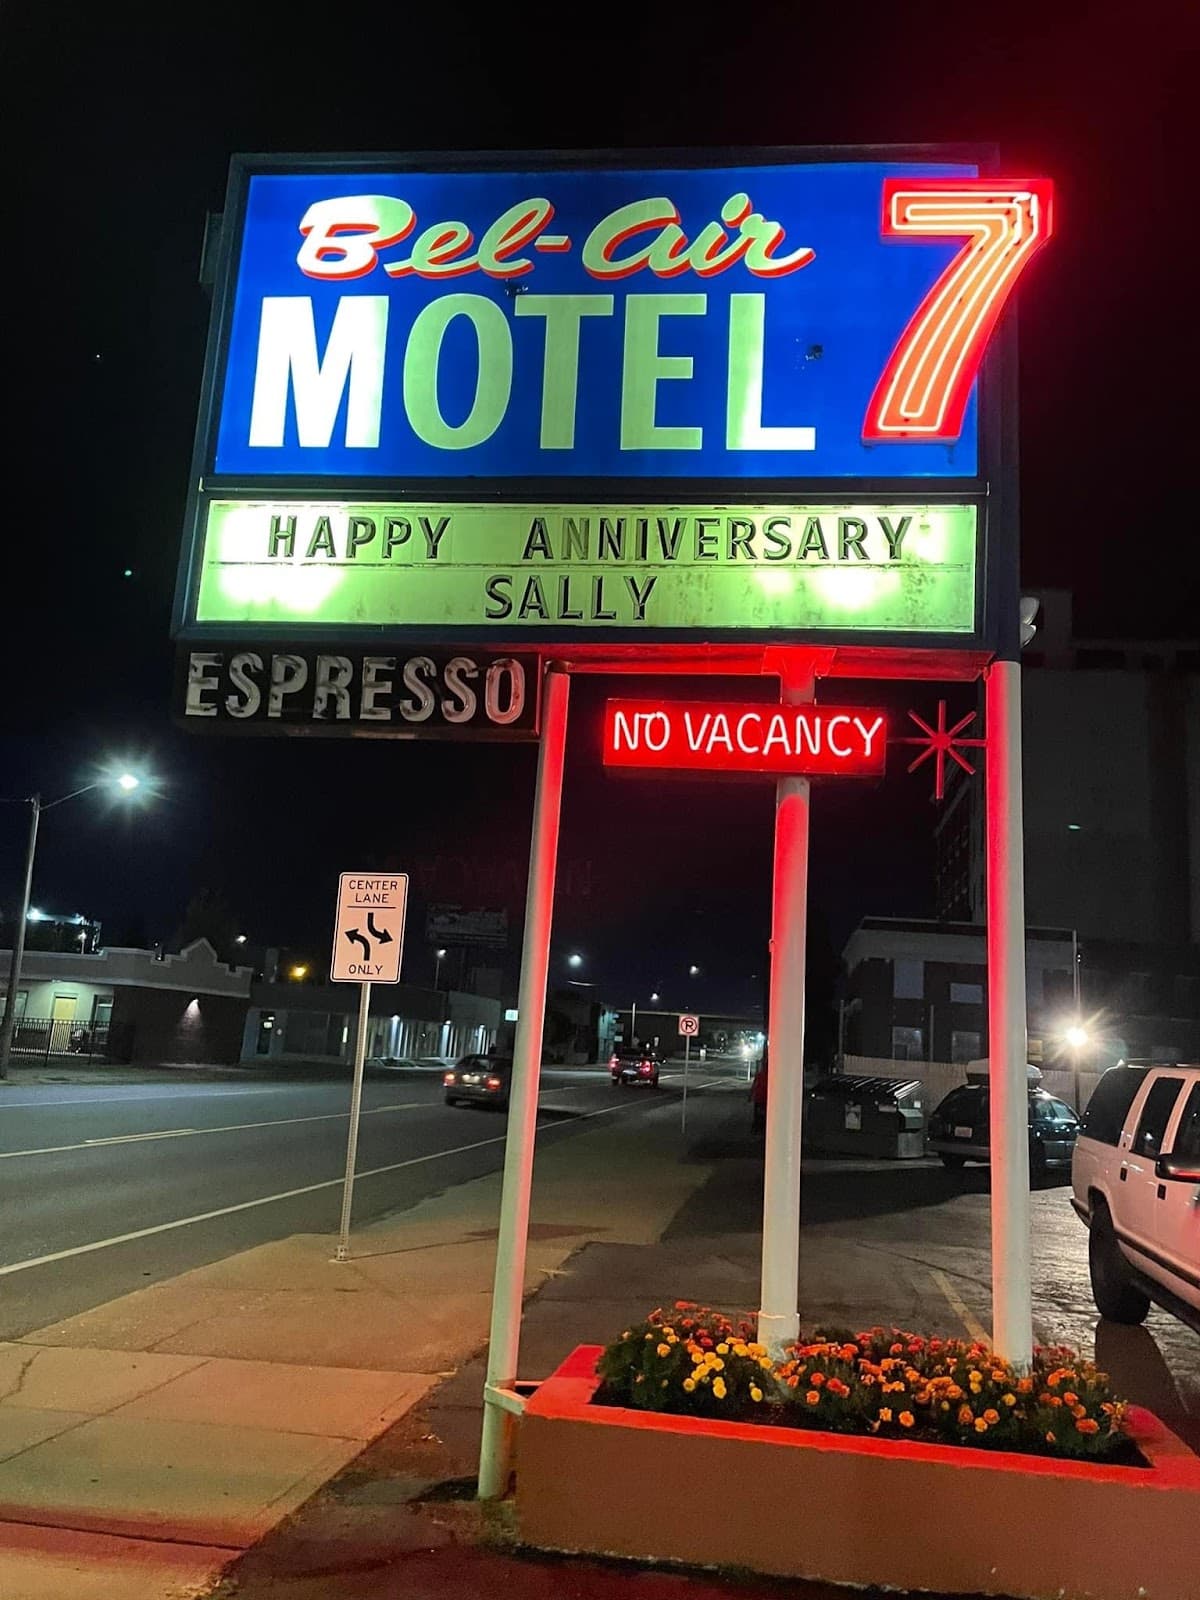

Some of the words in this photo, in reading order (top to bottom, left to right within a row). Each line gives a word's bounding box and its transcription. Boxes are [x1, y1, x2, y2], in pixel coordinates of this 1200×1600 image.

[296, 192, 816, 280] Bel-Air
[248, 293, 816, 451] MOTEL
[861, 178, 1054, 445] 7
[267, 513, 453, 561] HAPPY
[521, 513, 914, 563] ANNIVERSARY
[484, 574, 659, 621] SALLY
[185, 651, 526, 724] ESPRESSO
[613, 711, 671, 751] NO
[683, 711, 884, 757] VACANCY
[348, 879, 398, 891] CENTER
[355, 892, 390, 904] LANE
[348, 963, 384, 975] ONLY
